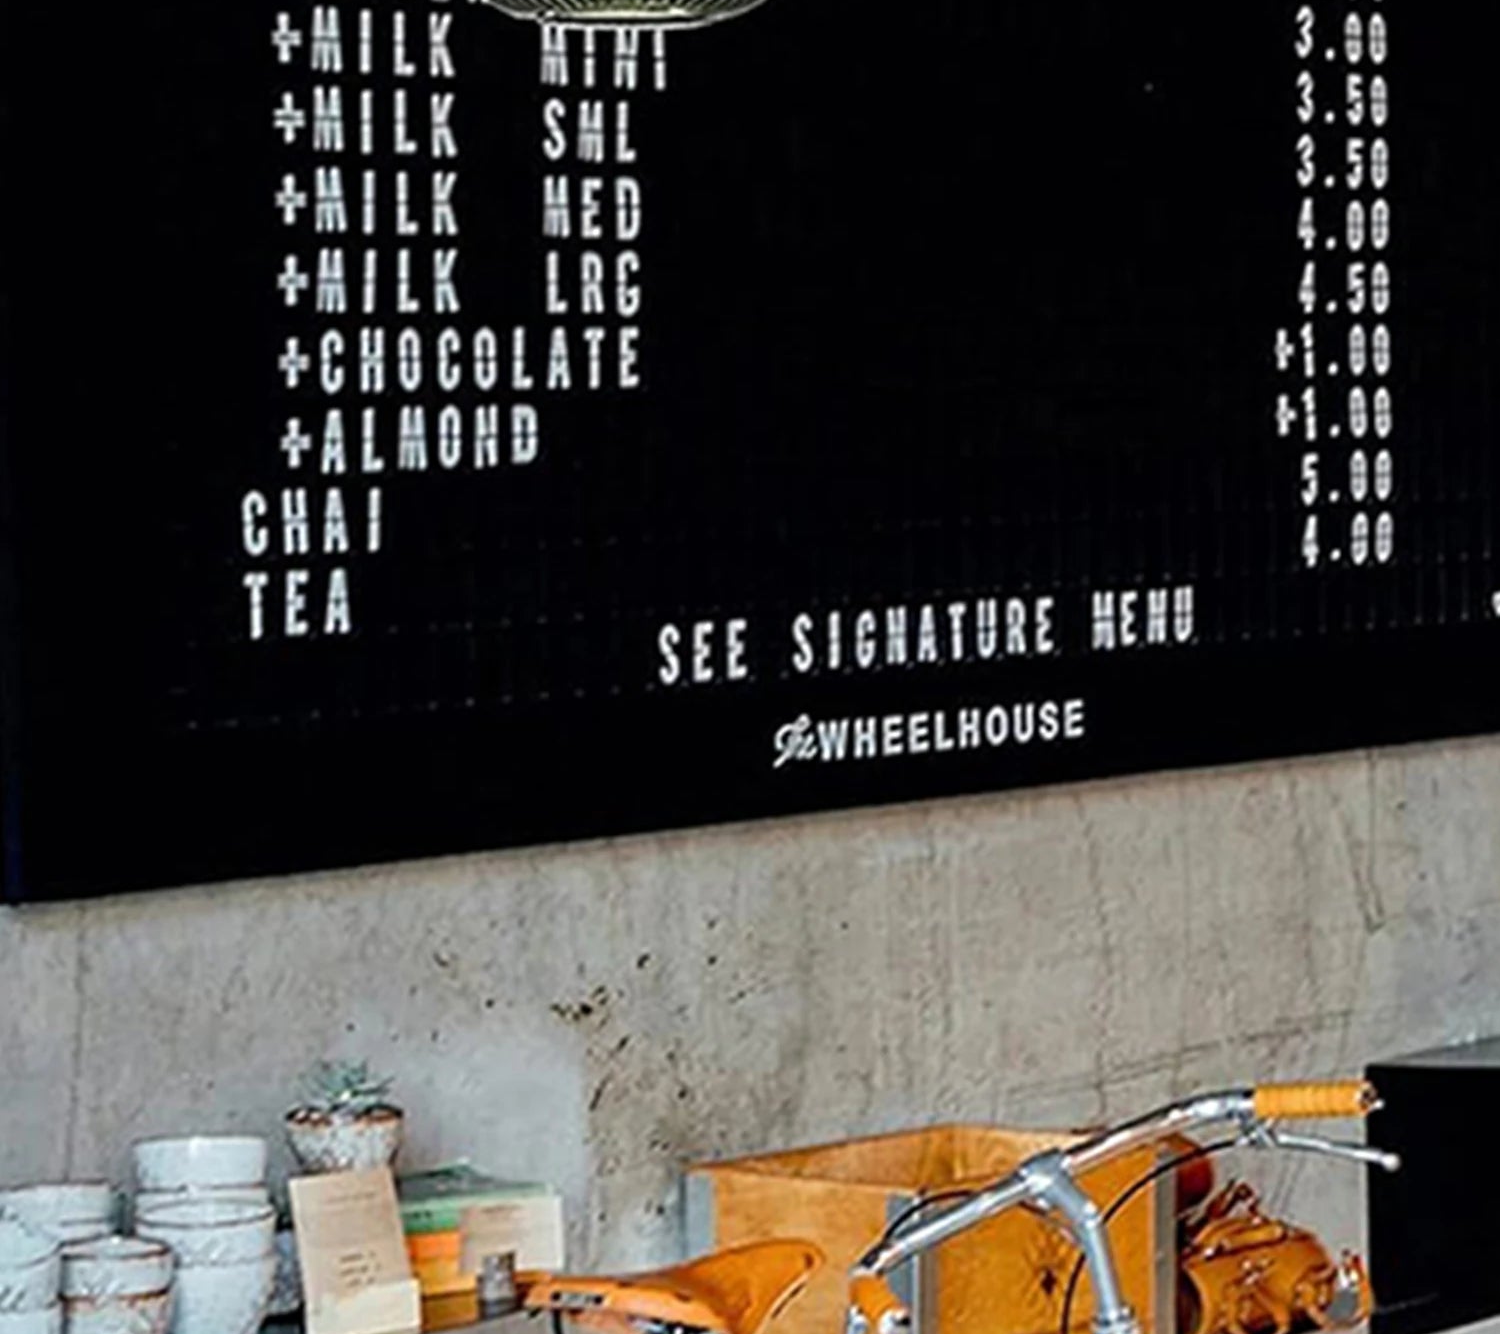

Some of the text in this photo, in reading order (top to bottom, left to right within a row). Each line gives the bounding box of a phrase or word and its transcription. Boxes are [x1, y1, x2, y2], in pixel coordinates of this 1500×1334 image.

[271, 4, 667, 91] +MILK MINI
[1294, 4, 1389, 66] 3.00
[272, 84, 637, 164] +MILK SML
[1295, 69, 1389, 129] 3.50
[1296, 132, 1390, 191] 3.50
[274, 165, 642, 242] +MILK MED
[1297, 196, 1391, 252] 4.00
[276, 246, 642, 318] +MILK LRG
[1297, 260, 1391, 316] 4.50
[278, 325, 641, 395] +CHOCOLATE
[1275, 321, 1391, 379] +1.00
[280, 403, 539, 475] +ALMOND
[1276, 385, 1393, 442] +1.00
[1300, 448, 1394, 507] 5.00
[241, 486, 382, 557] CHAI
[1301, 510, 1395, 569] 4.00
[242, 567, 352, 641] TEA
[657, 584, 1195, 686] SEE SIGNATURE MENU
